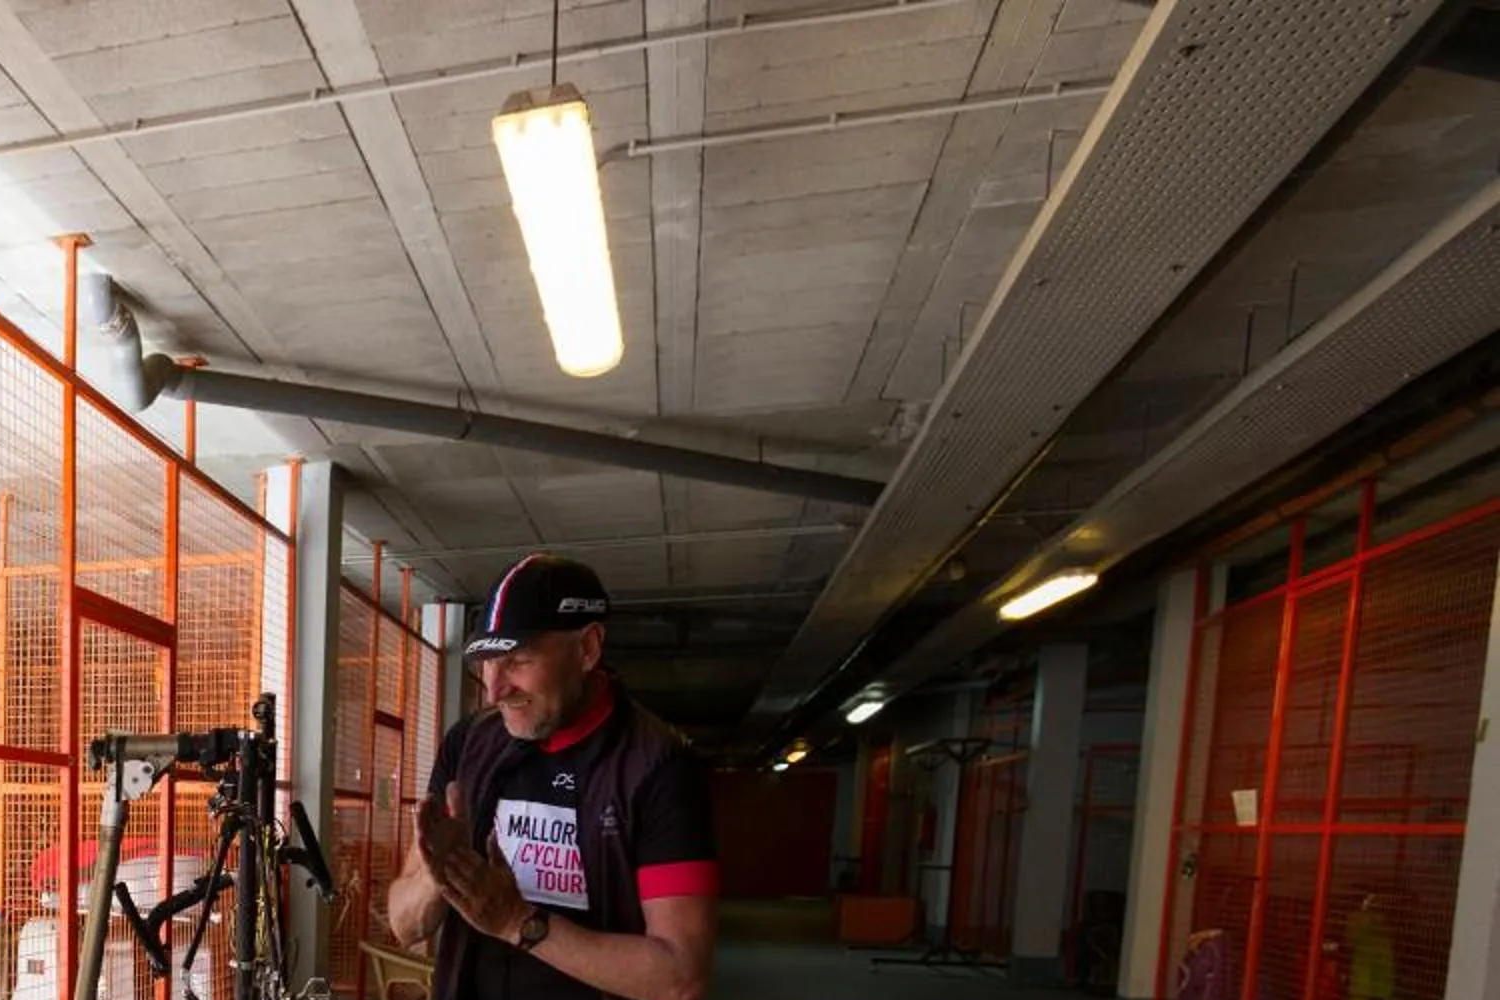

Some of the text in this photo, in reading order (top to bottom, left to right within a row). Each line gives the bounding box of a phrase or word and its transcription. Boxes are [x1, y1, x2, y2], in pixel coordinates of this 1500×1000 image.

[507, 814, 578, 846] MALLOR
[520, 843, 583, 871] CYCLIN
[535, 868, 588, 895] TOUR
